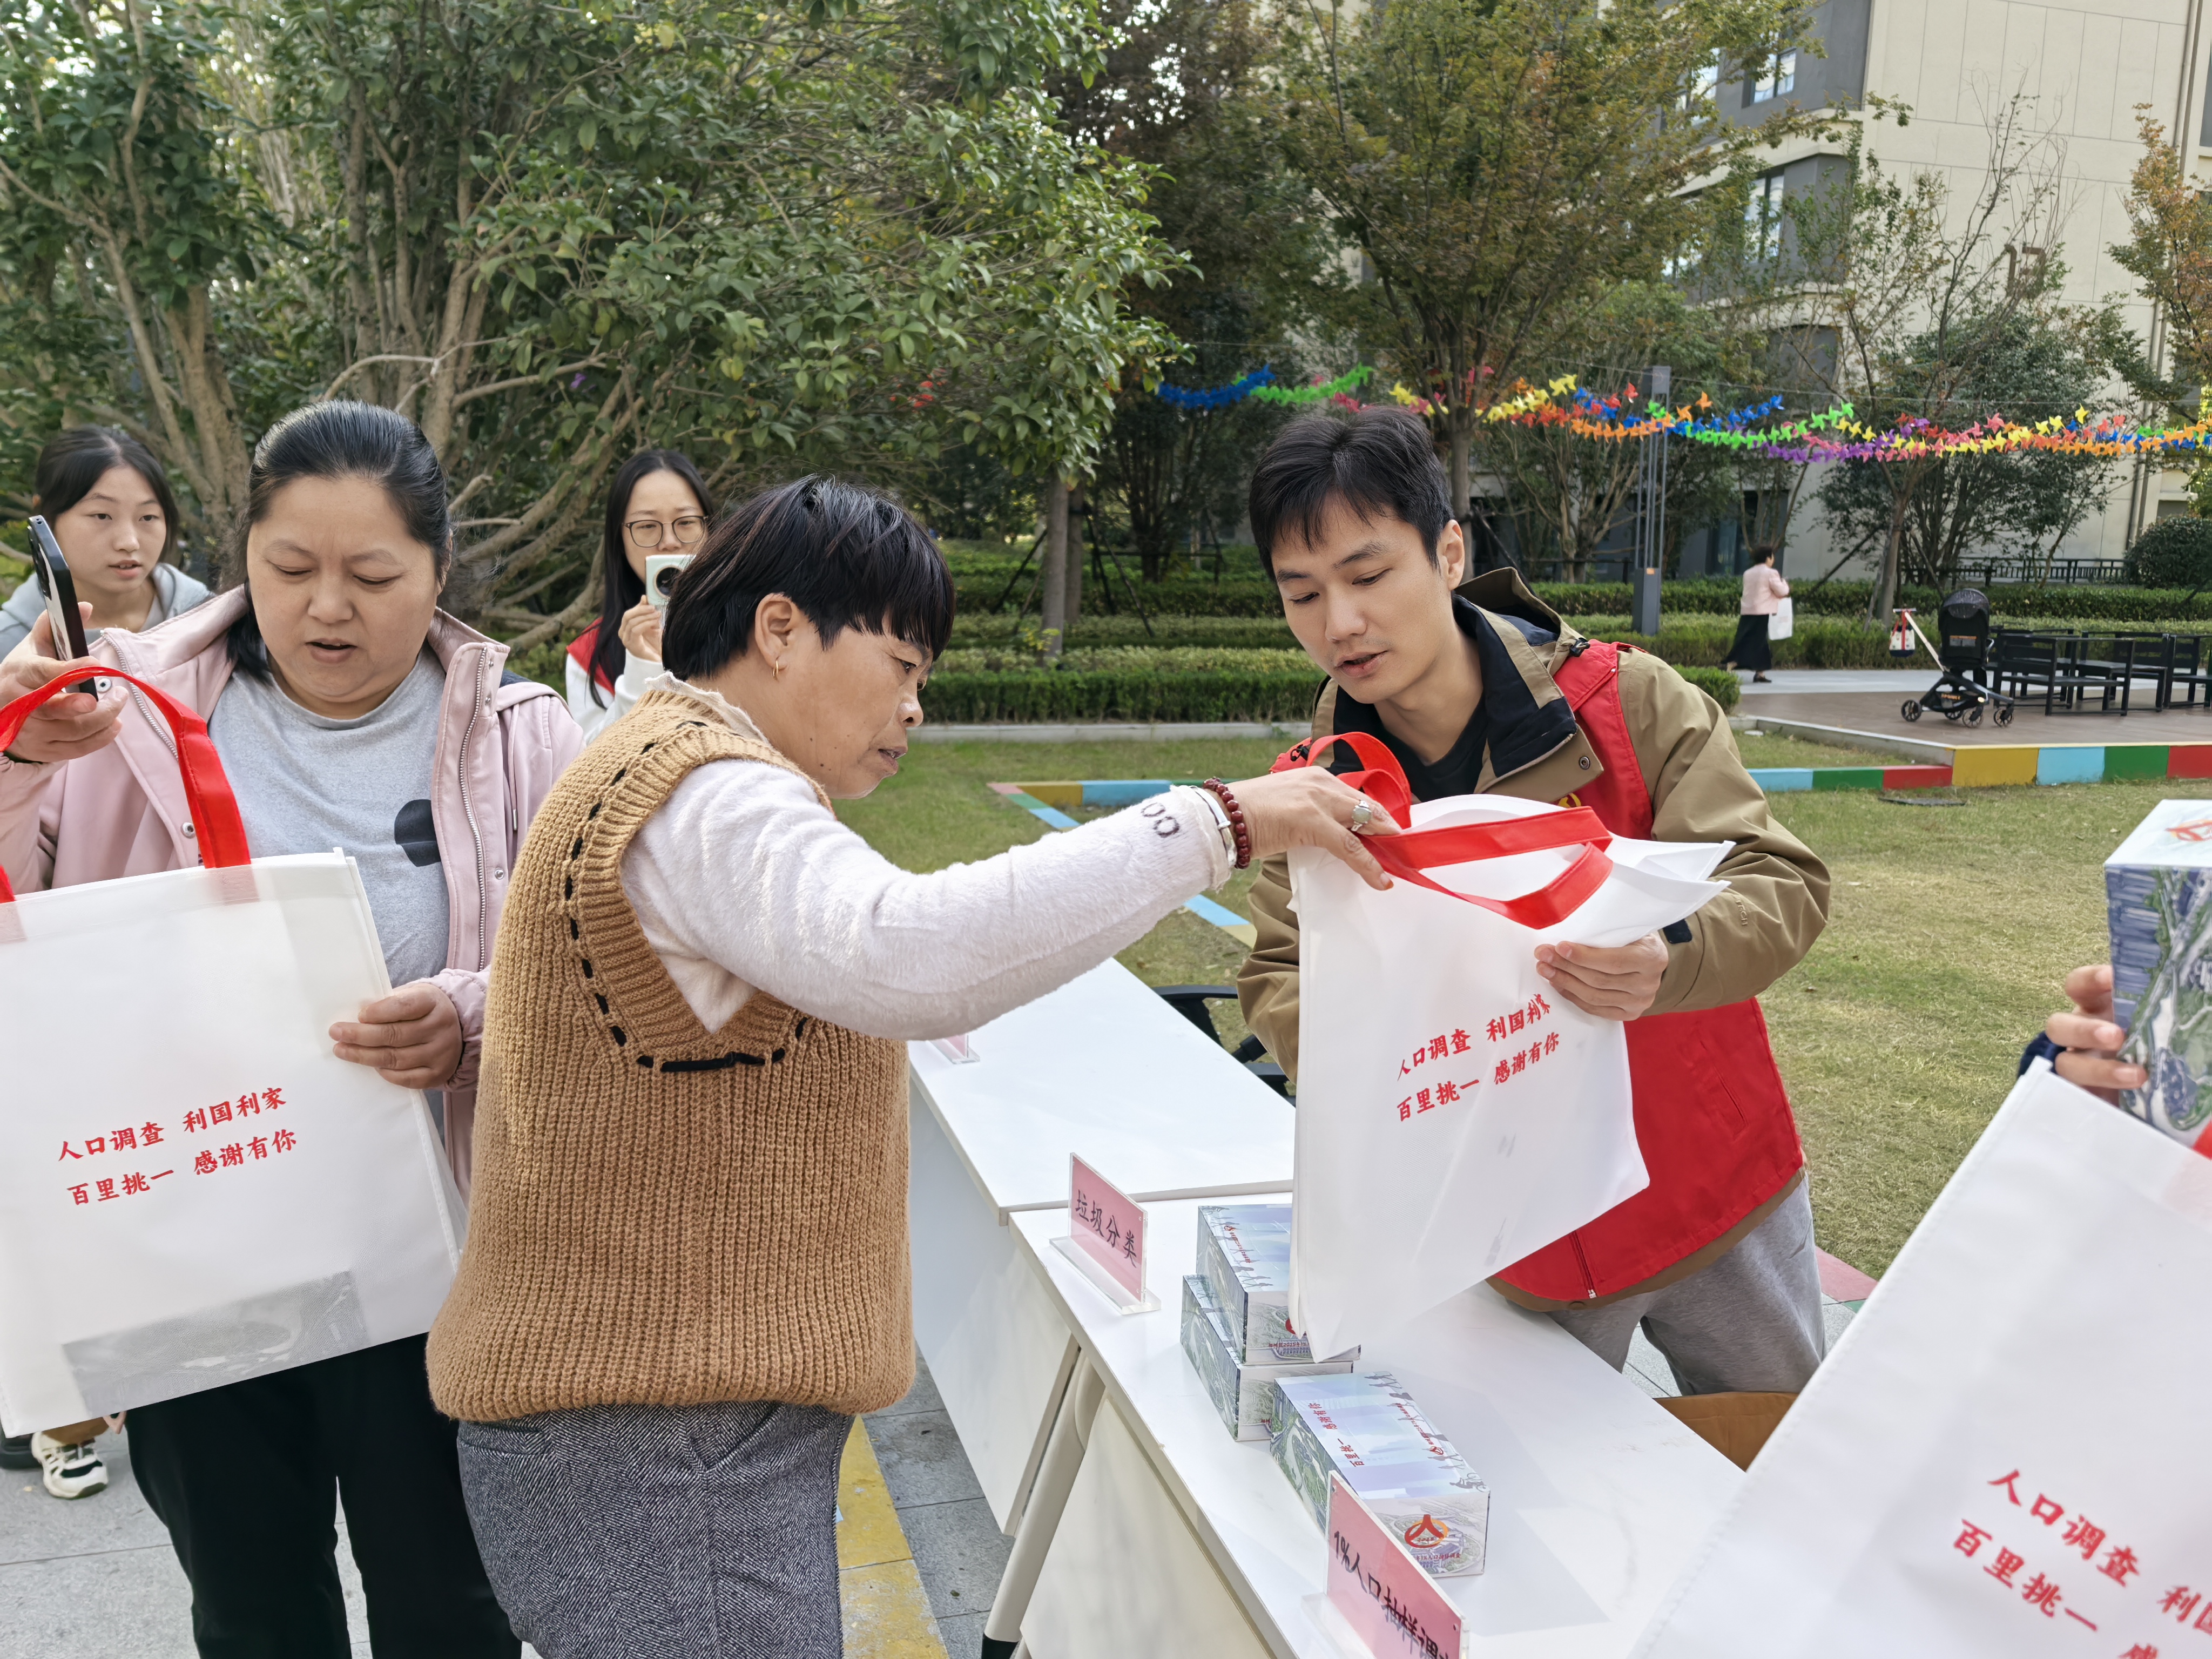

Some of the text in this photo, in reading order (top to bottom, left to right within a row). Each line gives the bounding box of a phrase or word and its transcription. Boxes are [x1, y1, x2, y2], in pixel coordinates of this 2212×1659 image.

[1398, 1029, 1471, 1081] 人口调查
[1398, 1033, 1559, 1121] 百里挑一 感谢有你
[58, 1088, 286, 1161] 人口调查 利国利家
[67, 1129, 296, 1205] 百里挑一 感谢有你
[1076, 1190, 1136, 1268] 垃圾分类
[1338, 1438, 1365, 1467] 百里挑一
[1988, 1469, 2139, 1587] 人口调查
[1954, 1520, 2098, 1631] 百里挑一
